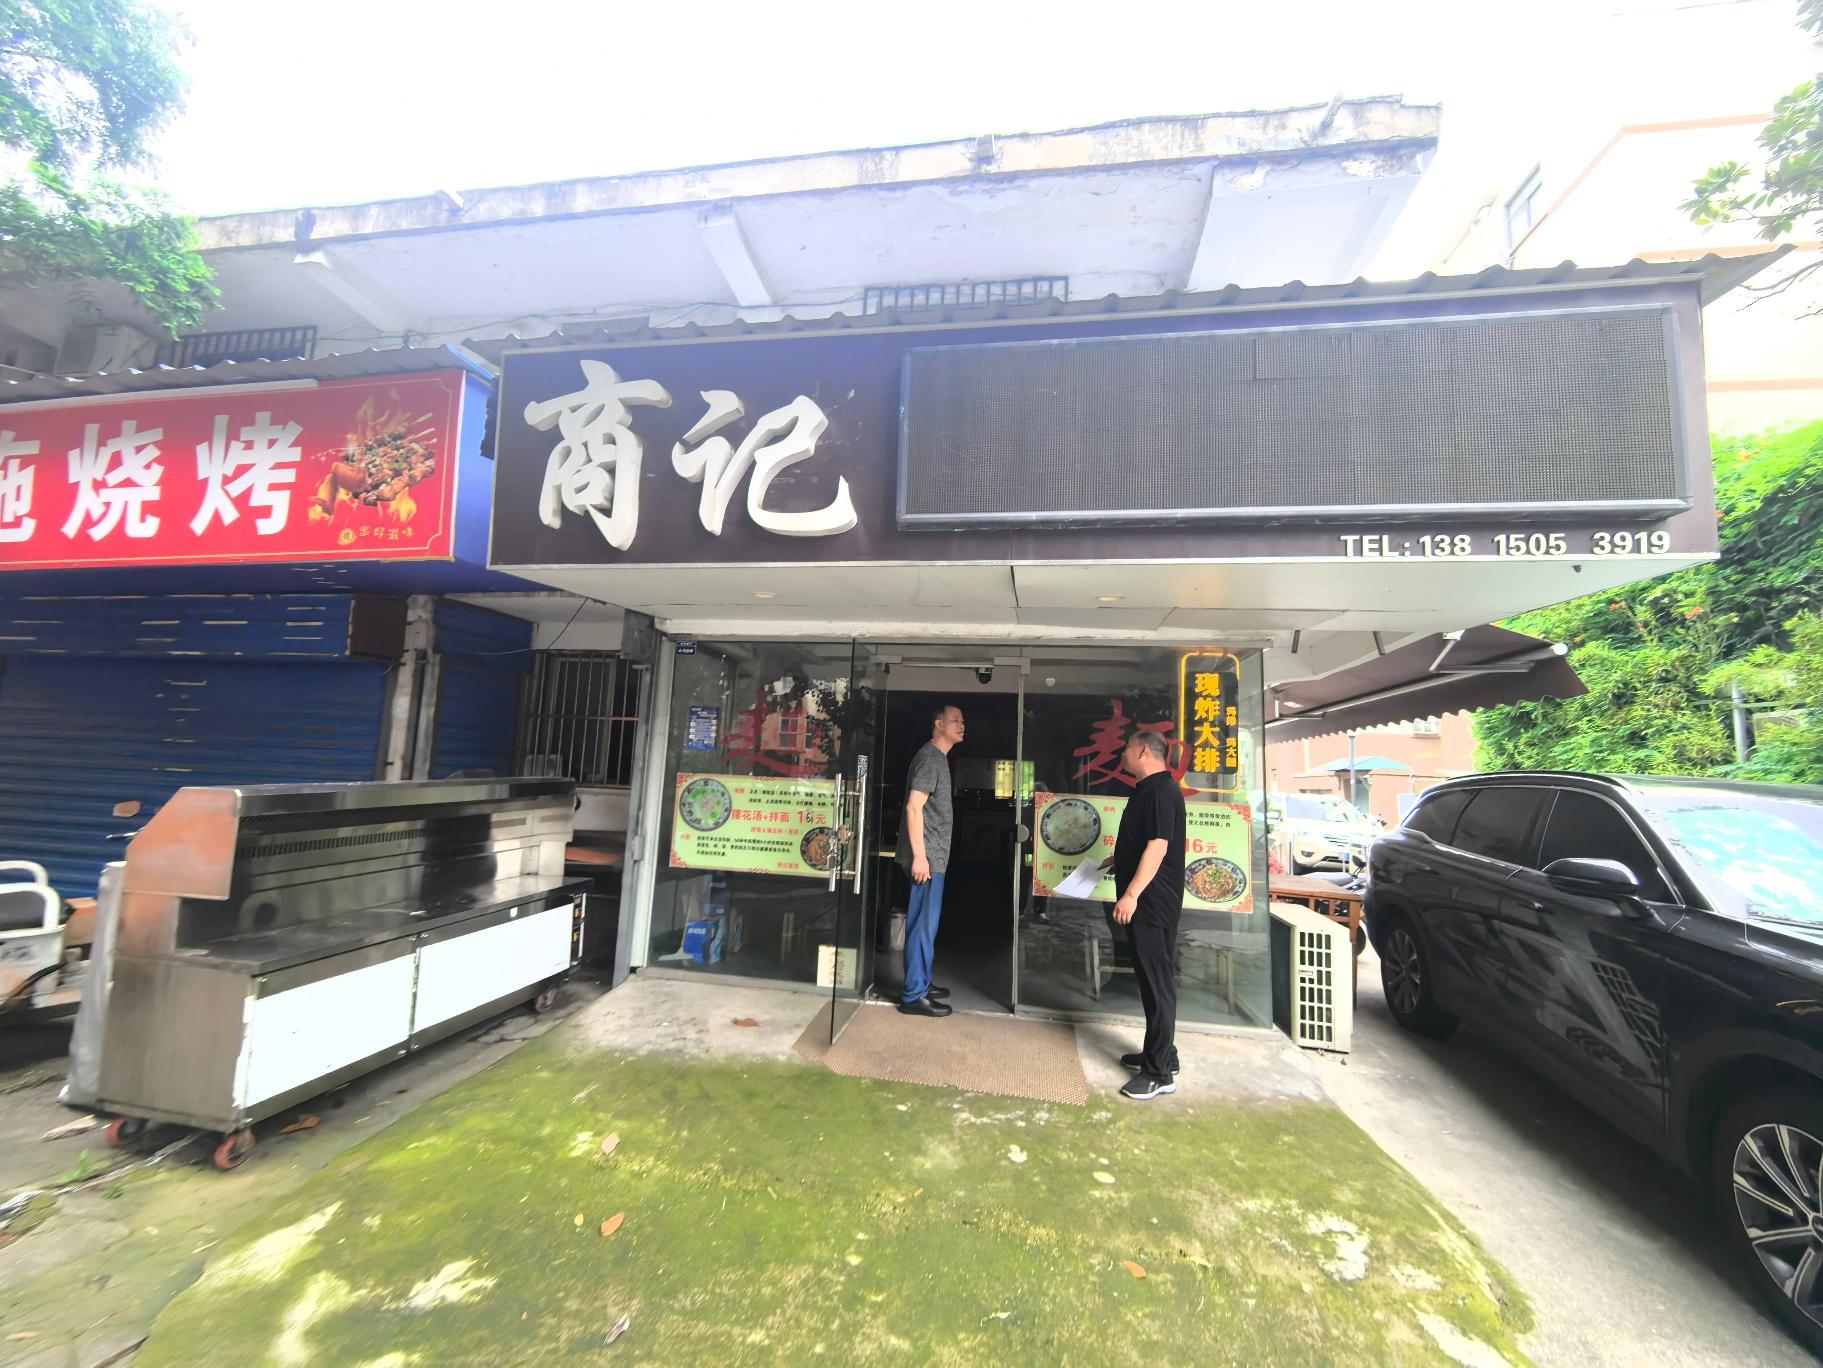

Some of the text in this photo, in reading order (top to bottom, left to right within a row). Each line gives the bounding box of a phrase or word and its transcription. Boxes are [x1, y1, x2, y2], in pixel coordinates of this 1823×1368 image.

[524, 360, 858, 551] 商记
[1494, 533, 1567, 557] 1505
[1593, 530, 1671, 555] 3919
[1194, 672, 1220, 773] 现炸大排
